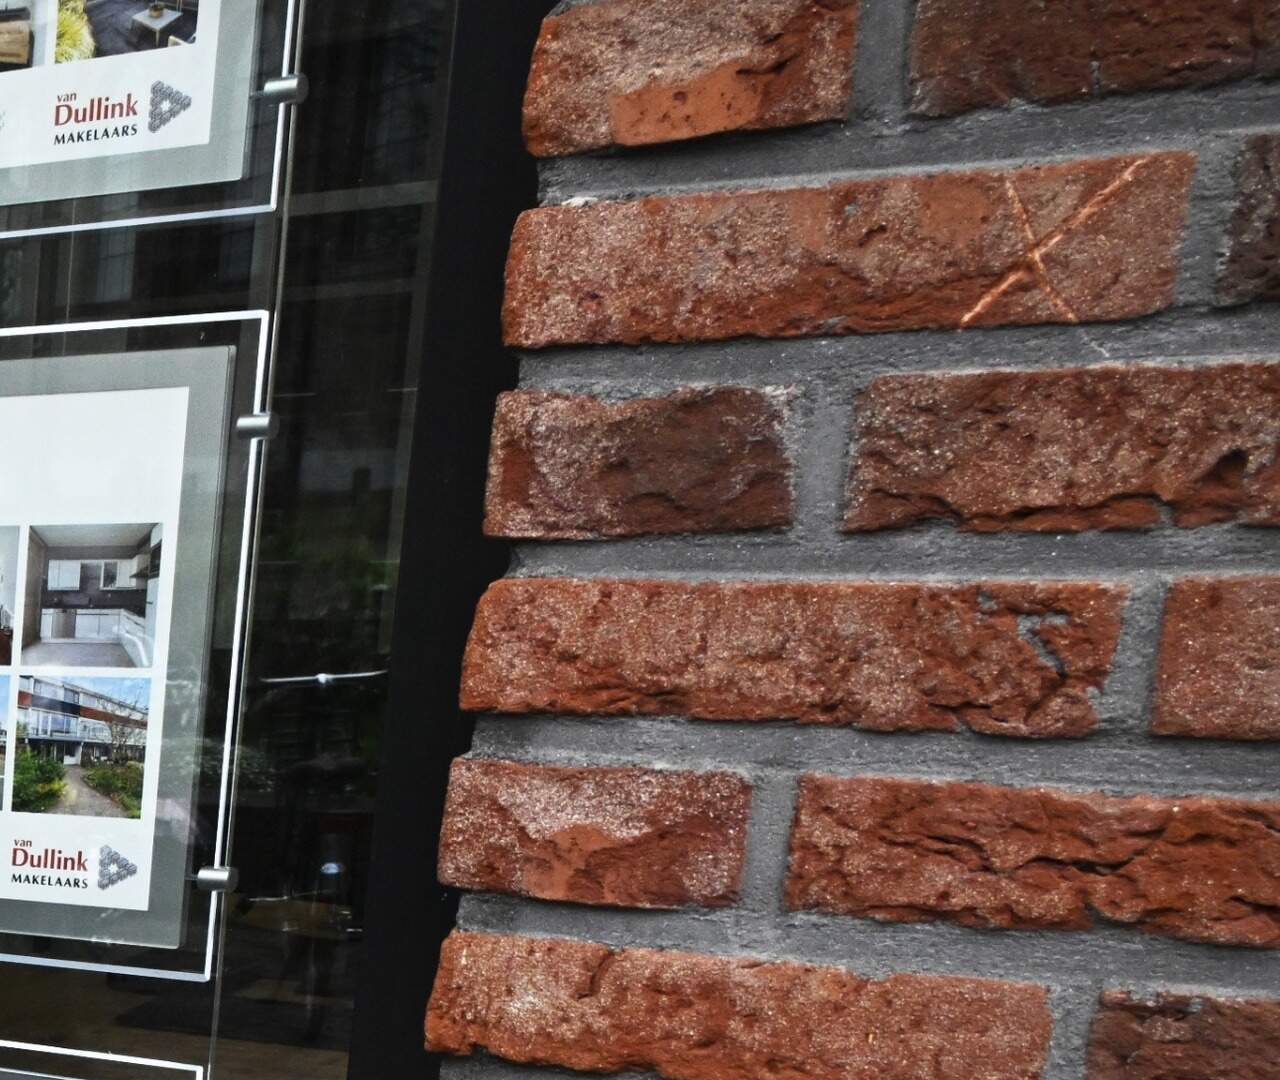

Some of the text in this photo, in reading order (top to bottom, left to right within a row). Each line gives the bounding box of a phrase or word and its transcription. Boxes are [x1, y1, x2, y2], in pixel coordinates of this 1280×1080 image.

[57, 92, 77, 103] van
[54, 93, 138, 126] Dullink
[53, 124, 138, 146] MAKELAARS
[14, 839, 32, 847] van
[11, 848, 88, 872] Dullink
[11, 873, 88, 889] MAKELAARS
